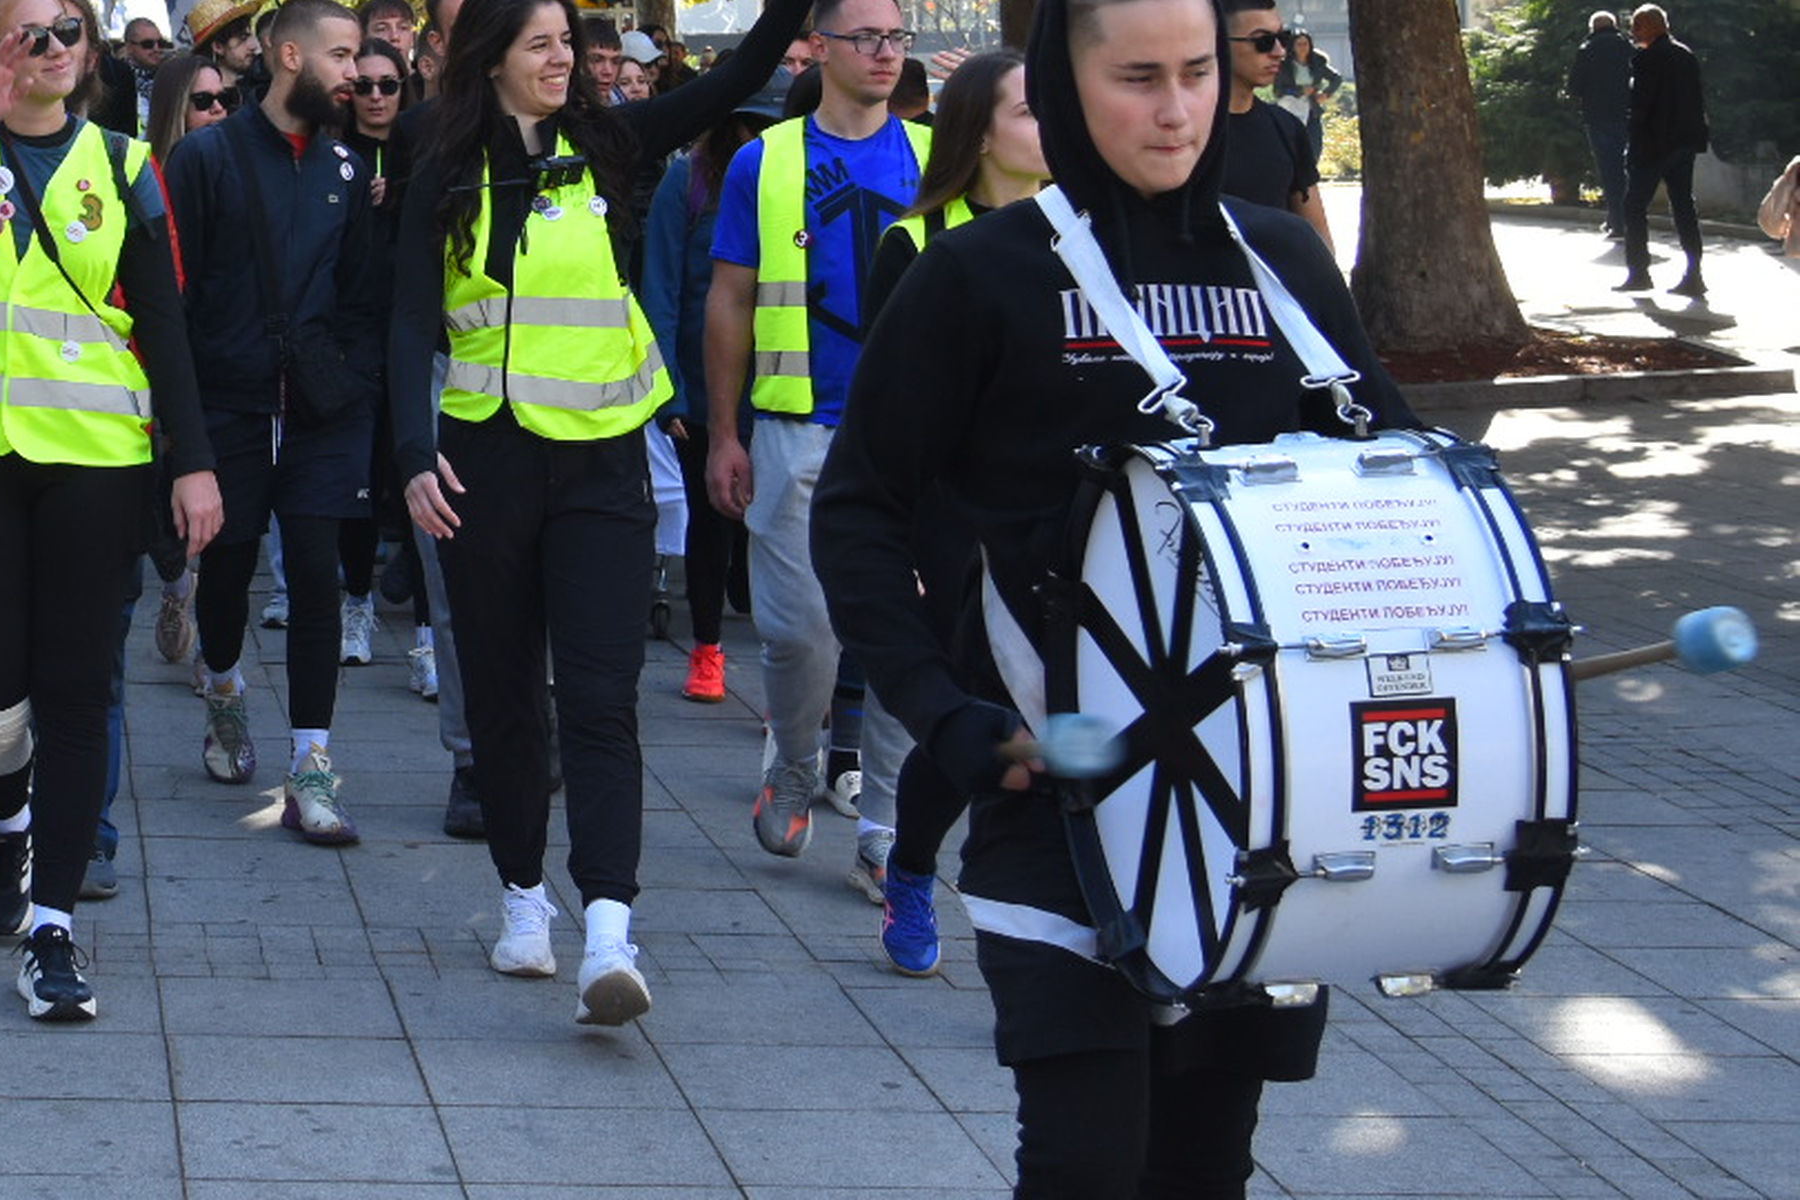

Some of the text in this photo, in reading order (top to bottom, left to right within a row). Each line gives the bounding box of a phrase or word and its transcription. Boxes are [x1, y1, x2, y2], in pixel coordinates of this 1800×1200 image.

[1058, 284, 1268, 343] ПНЦИП
[1272, 501, 1349, 511] СТУДЕНТИ
[1275, 521, 1352, 533] СТУДЕНТИ
[1289, 559, 1365, 573] СТУДЕНТИ
[1295, 581, 1373, 595] СТУДЕНТИ
[1301, 608, 1380, 623] СТУДЕНТИ
[1362, 720, 1447, 757] FCK
[1362, 755, 1449, 791] SNS
[1361, 811, 1450, 841] 1312
